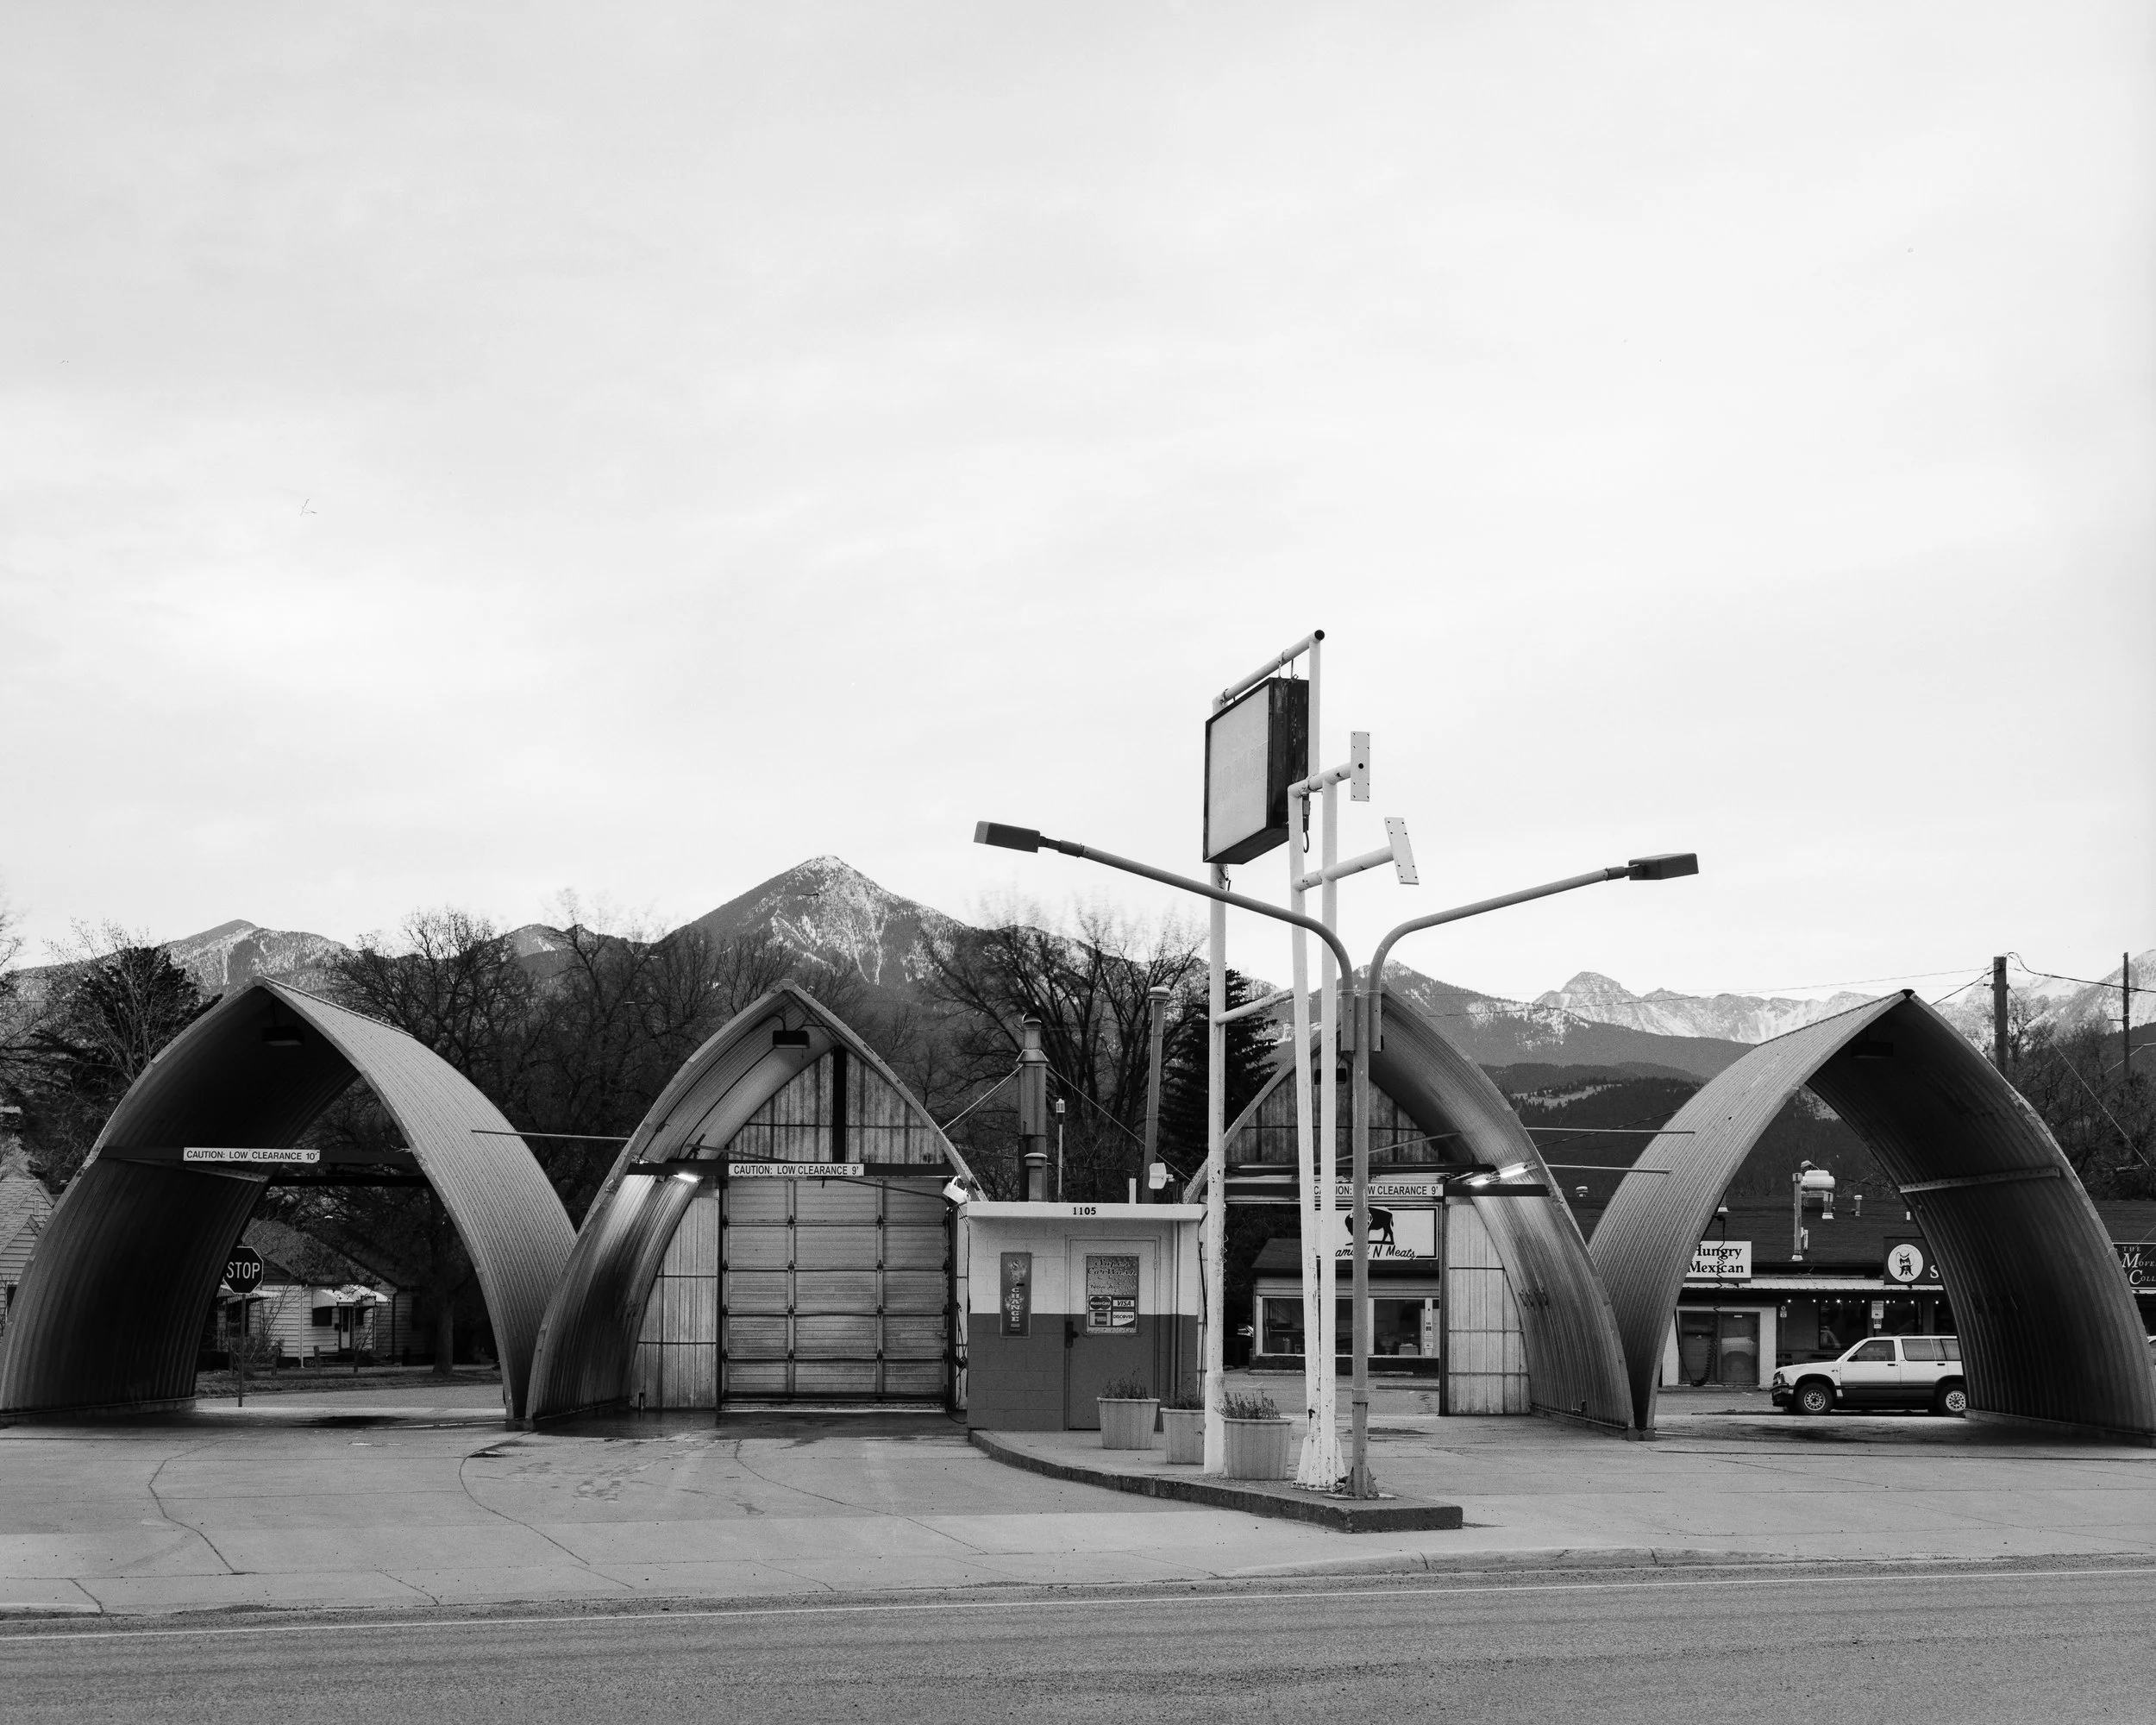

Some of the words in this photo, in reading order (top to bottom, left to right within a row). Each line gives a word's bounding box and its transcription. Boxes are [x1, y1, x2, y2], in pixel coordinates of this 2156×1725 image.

[251, 1151, 302, 1160] CLEARANCE
[734, 1165, 773, 1175] CAUTION:
[777, 1165, 795, 1175] LOW
[798, 1165, 848, 1175] CLEARANCE
[851, 1165, 859, 1175] 9'
[1377, 1186, 1427, 1195] CLEARANCE
[1431, 1186, 1438, 1195] 9'
[1073, 1207, 1097, 1215] 1105
[1372, 1244, 1383, 1258] N
[1385, 1244, 1416, 1258] Meats
[226, 1261, 260, 1279] STOP
[1688, 1261, 1744, 1273] Mexican
[1010, 1287, 1020, 1322] CHANGE
